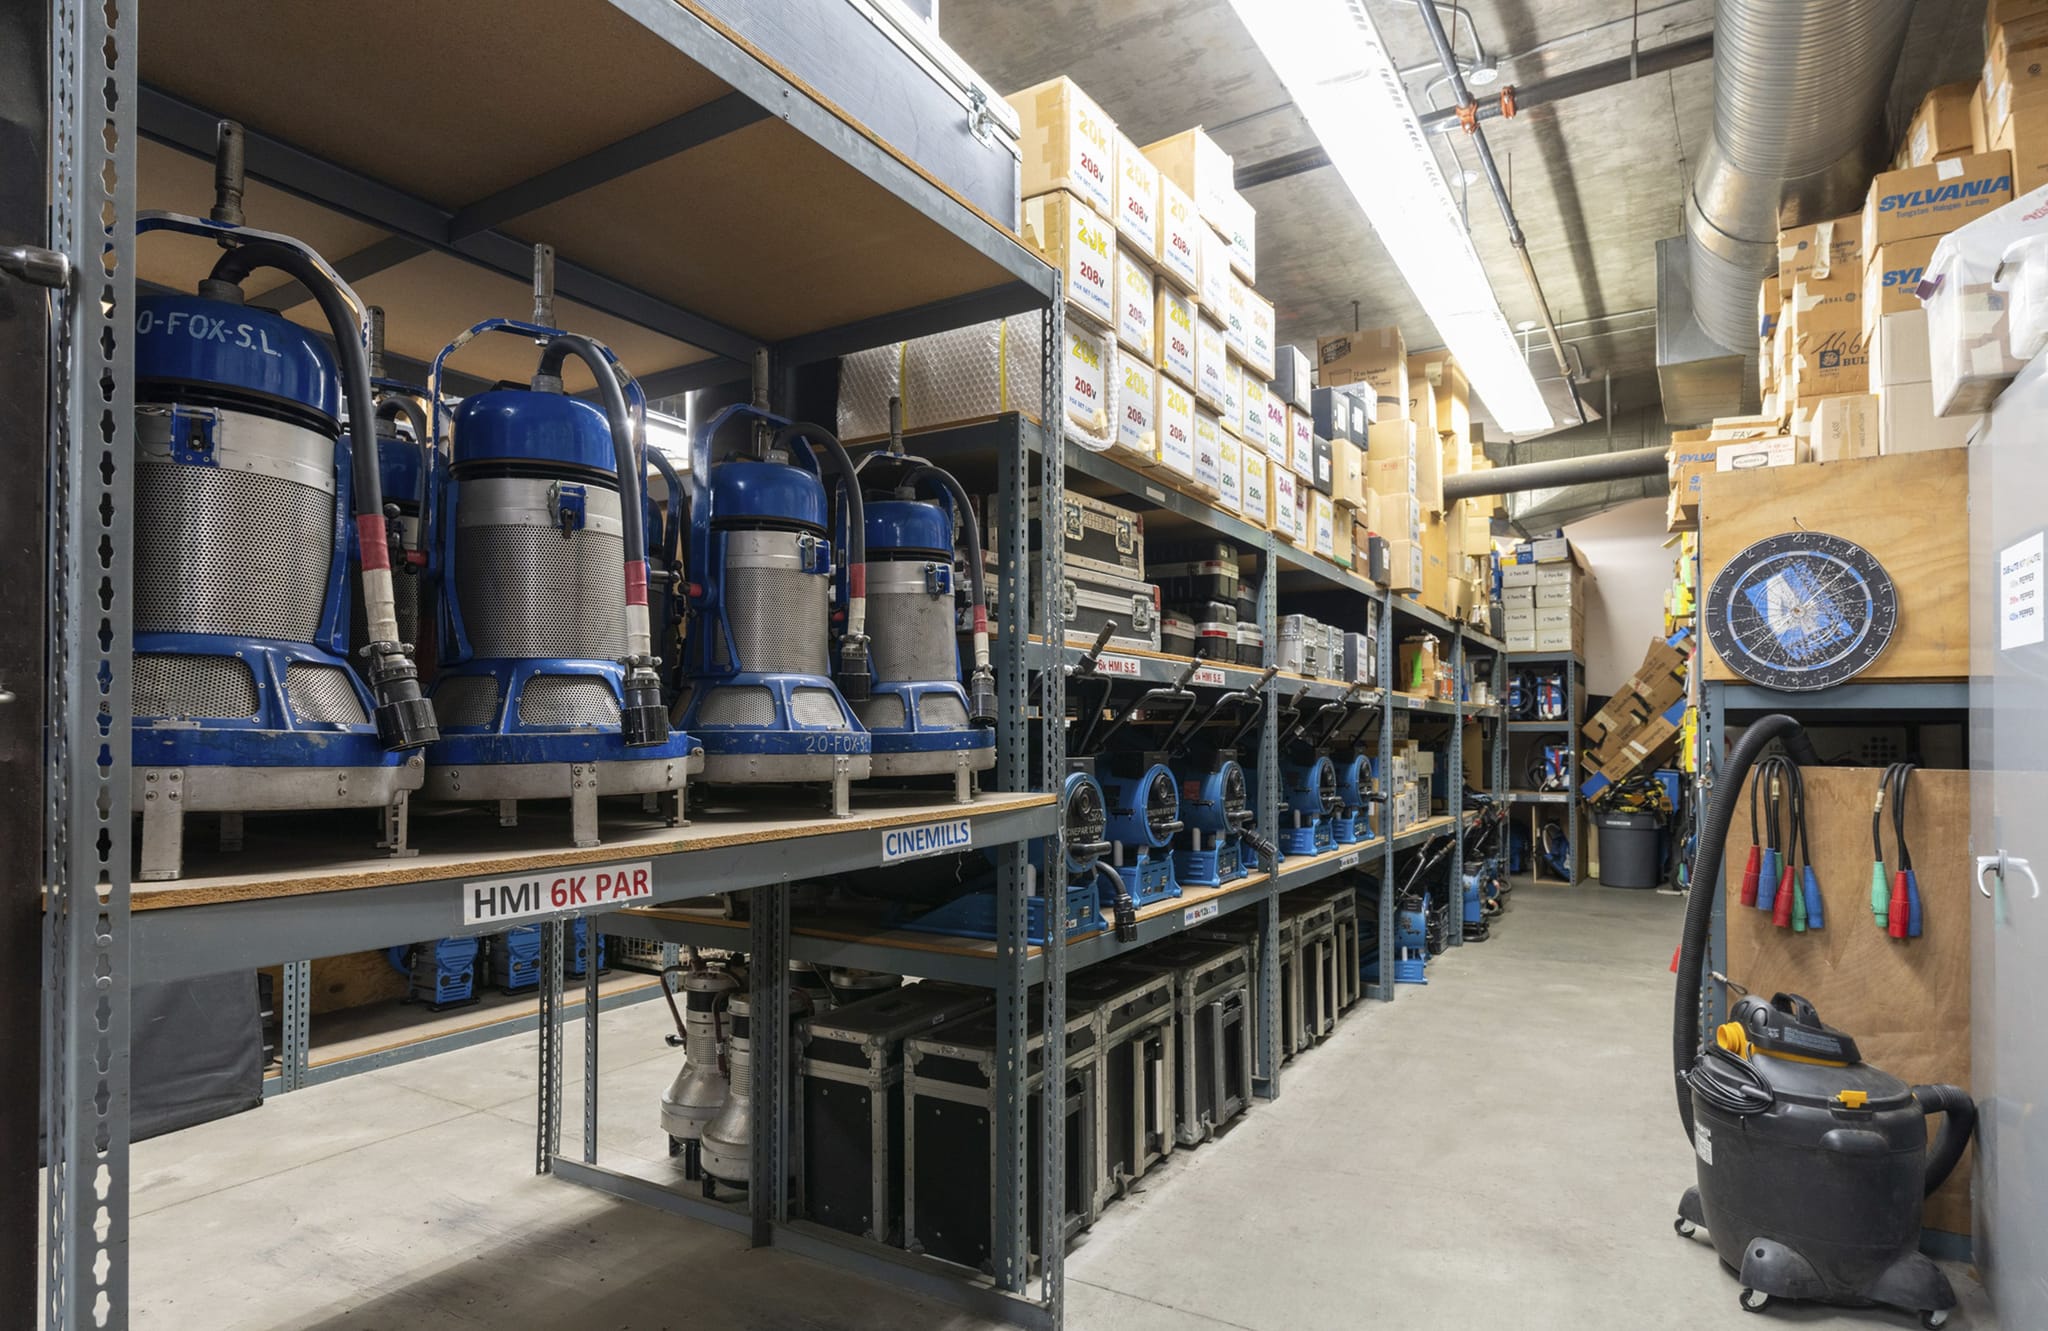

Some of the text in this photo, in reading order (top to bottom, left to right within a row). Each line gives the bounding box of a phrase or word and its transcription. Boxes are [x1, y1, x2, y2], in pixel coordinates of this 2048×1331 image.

[1879, 176, 2010, 212] SYLVANIA
[1108, 659, 1123, 673] HMI
[1124, 661, 1138, 674] S.E.
[1201, 673, 1213, 683] HMI
[885, 822, 970, 856] CINEMILLS
[473, 868, 649, 919] HMI 6K PAR
